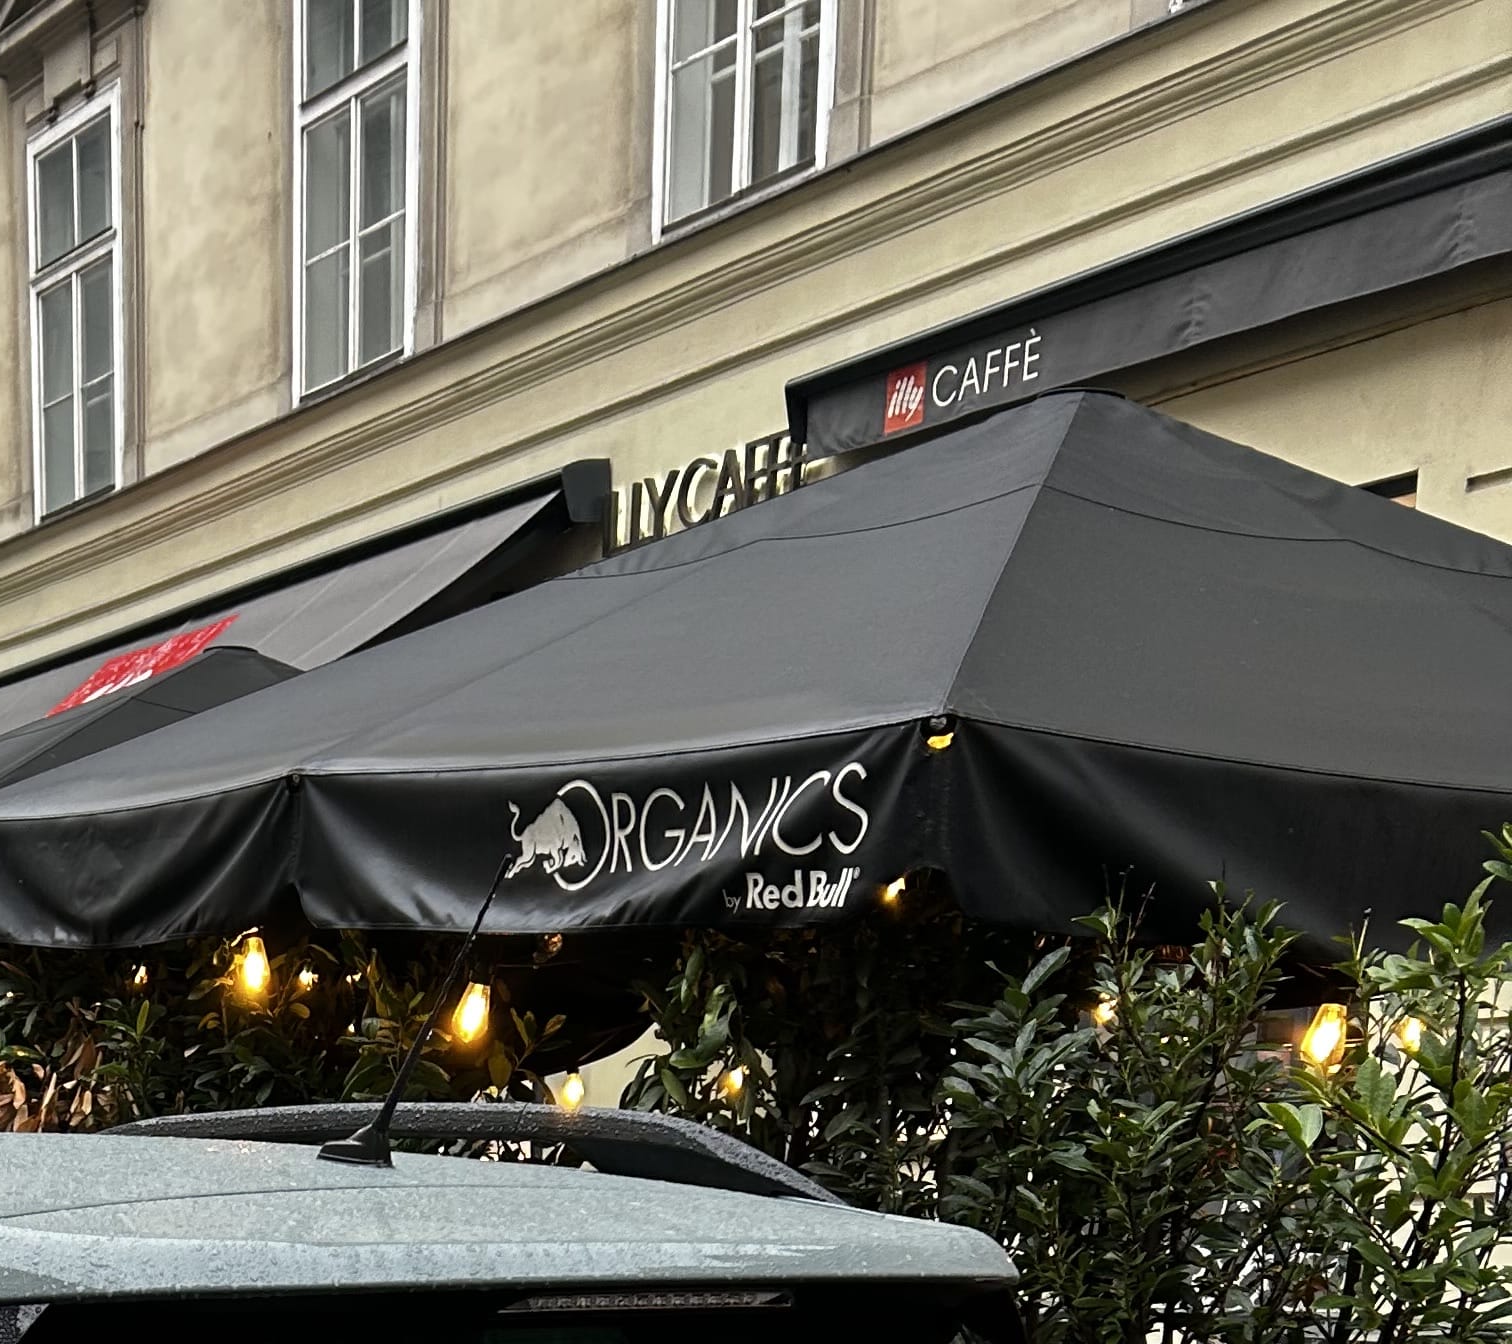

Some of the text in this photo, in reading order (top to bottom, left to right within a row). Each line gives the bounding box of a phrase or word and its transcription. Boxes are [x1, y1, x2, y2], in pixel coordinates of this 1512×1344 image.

[888, 328, 1041, 422] illy CAFFÈ
[552, 761, 869, 891] ORGANICS
[722, 888, 742, 914] by
